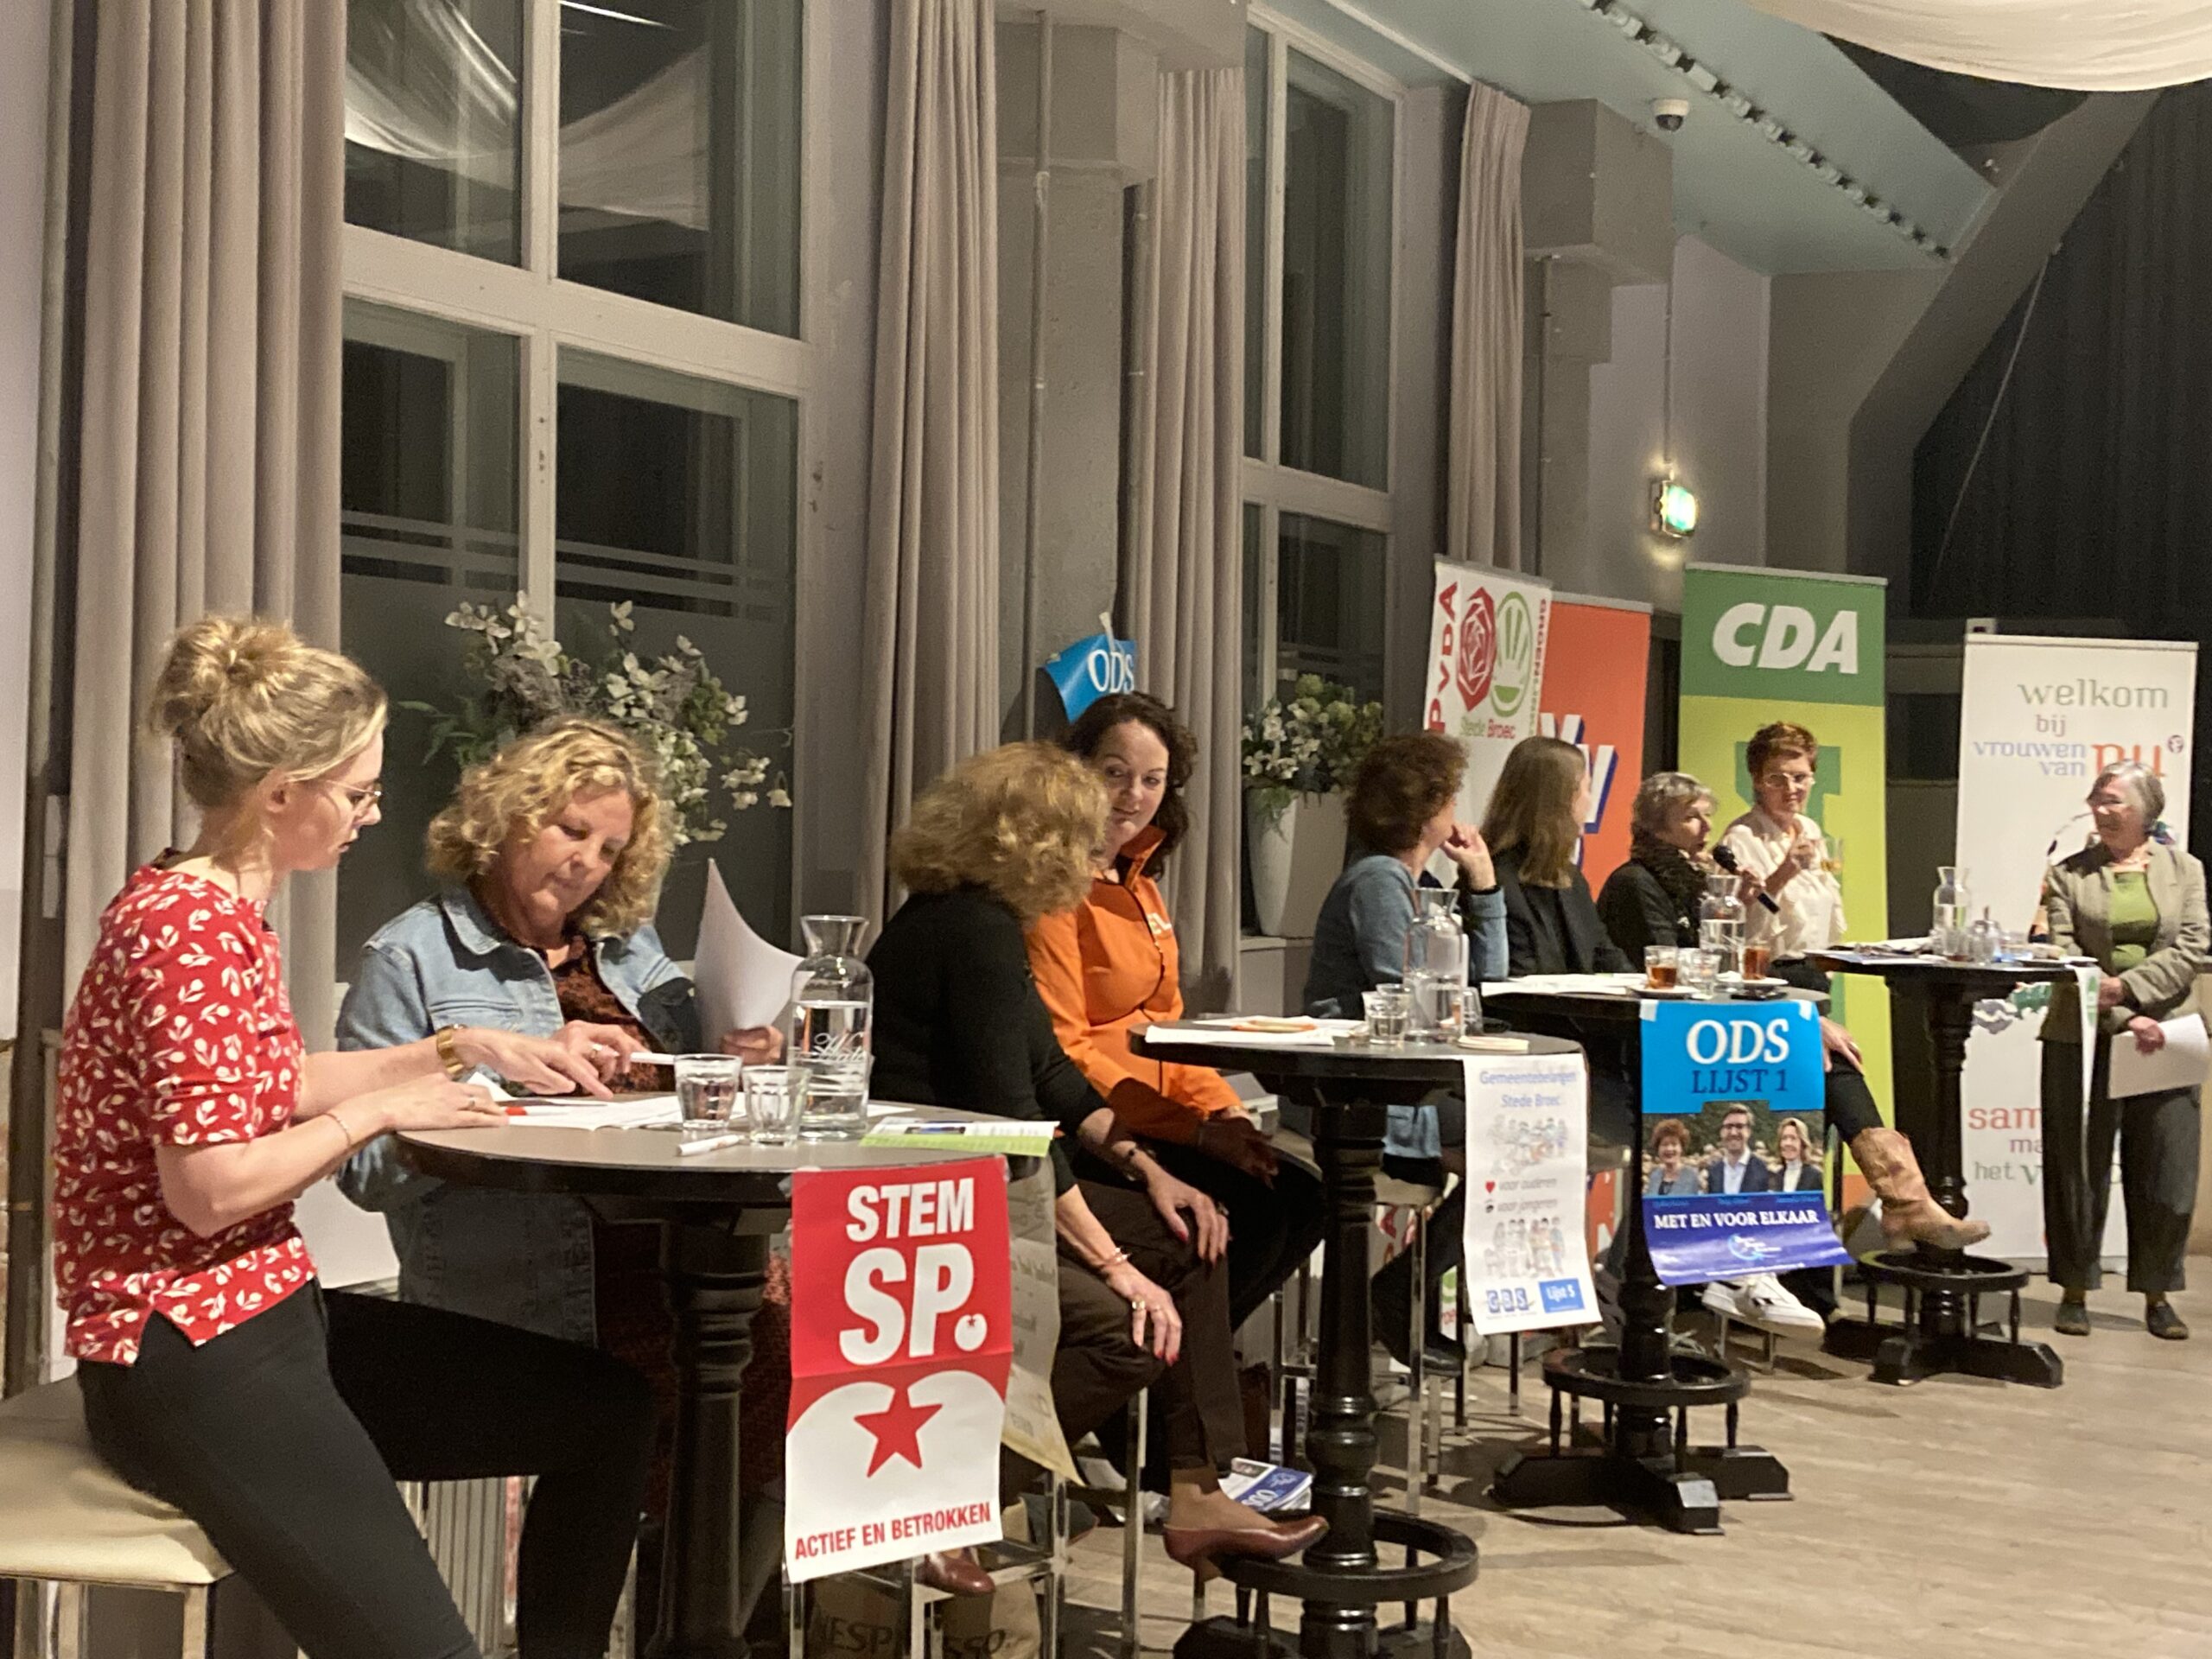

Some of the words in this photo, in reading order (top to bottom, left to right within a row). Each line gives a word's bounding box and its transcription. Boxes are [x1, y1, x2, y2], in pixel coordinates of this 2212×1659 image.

[1712, 602, 1859, 675] CDA
[1428, 581, 1458, 734] PVDA
[1088, 649, 1135, 695] ODS
[2018, 678, 2169, 708] welkom
[2037, 714, 2066, 737] bij
[1973, 741, 2086, 759] vrouwen
[2039, 761, 2086, 777] van
[1687, 1018, 1790, 1065] ODS
[1692, 1069, 1769, 1094] LIJST
[1777, 1069, 1789, 1092] 1
[1968, 1107, 2043, 1130] sam
[1974, 1161, 2014, 1181] het
[846, 1178, 975, 1243] STEM
[1654, 1213, 1688, 1230] MET
[1689, 1212, 1713, 1228] EN
[1713, 1211, 1759, 1227] VOOR
[1760, 1209, 1821, 1225] ELKAAR
[795, 1527, 856, 1560] ACTIEF
[861, 1522, 885, 1547] EN
[891, 1501, 991, 1541] BETROKKEN
